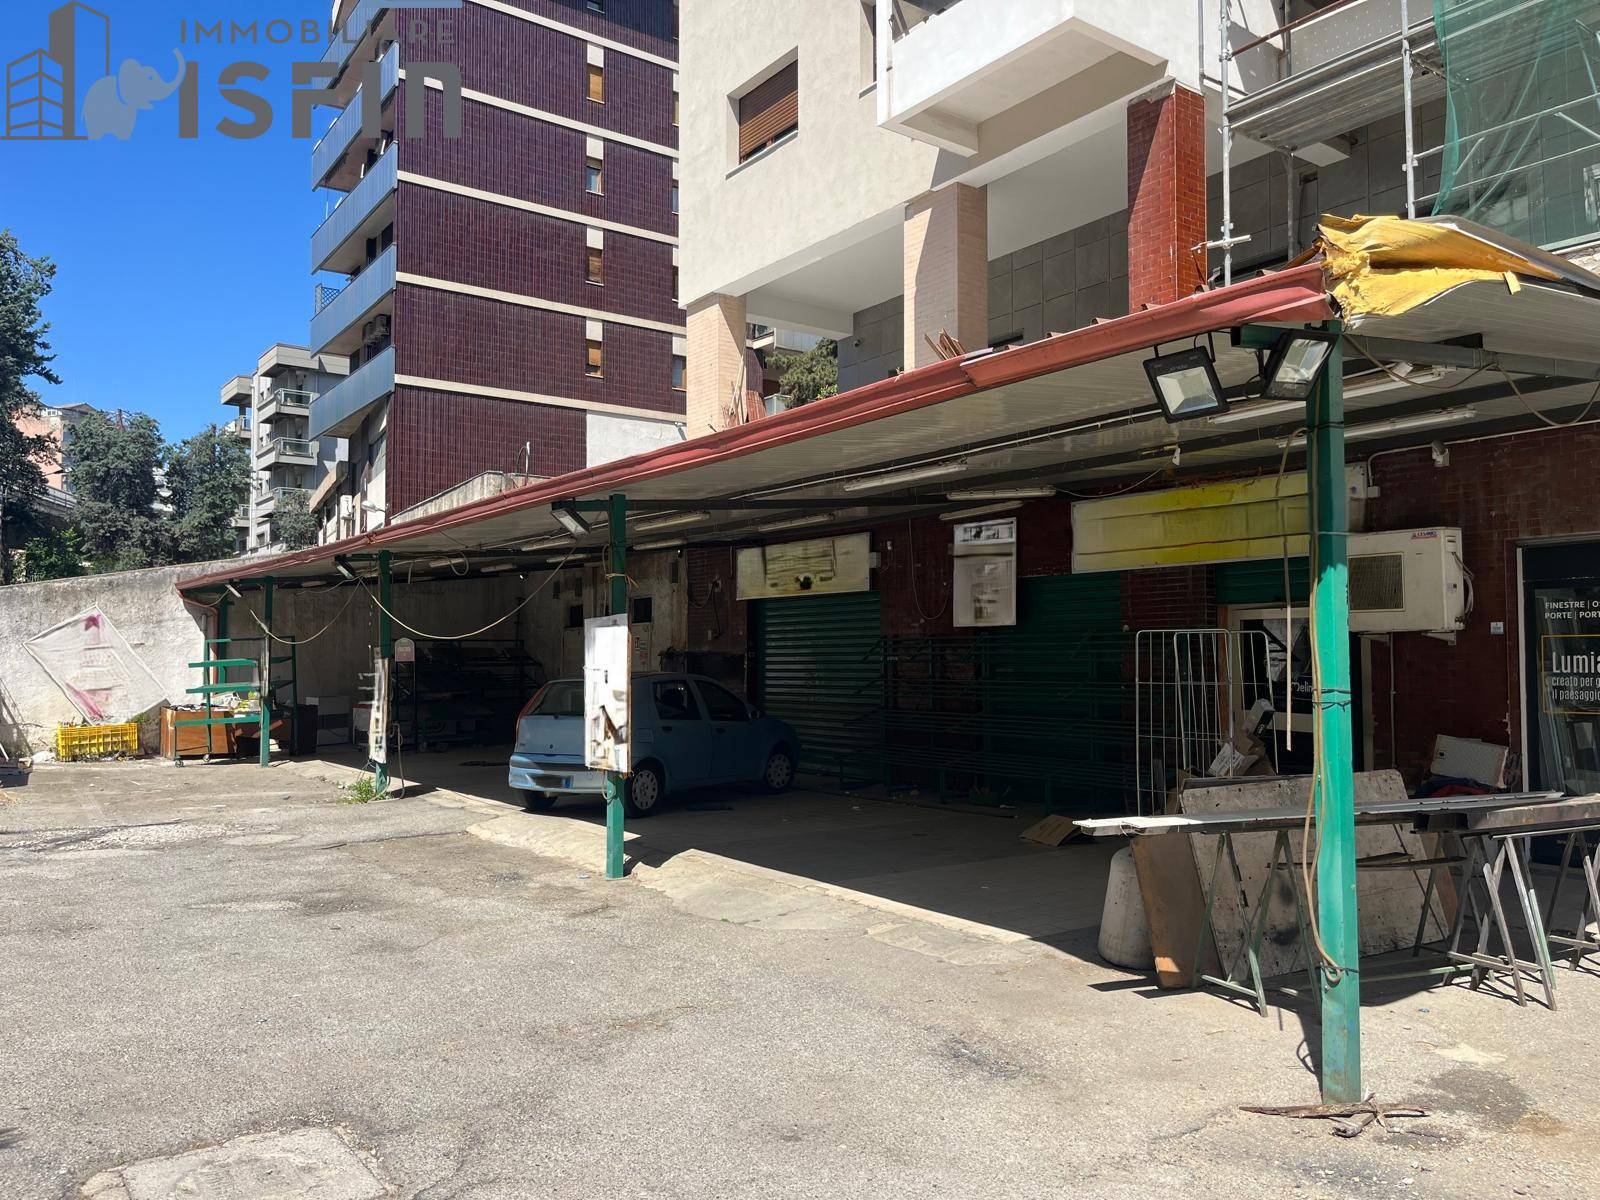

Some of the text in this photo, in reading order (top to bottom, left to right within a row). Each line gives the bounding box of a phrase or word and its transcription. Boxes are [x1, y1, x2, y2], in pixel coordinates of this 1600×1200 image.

[1545, 601, 1585, 609] FINESTRE
[1545, 611, 1572, 619] PORTE
[1580, 677, 1593, 687] per
